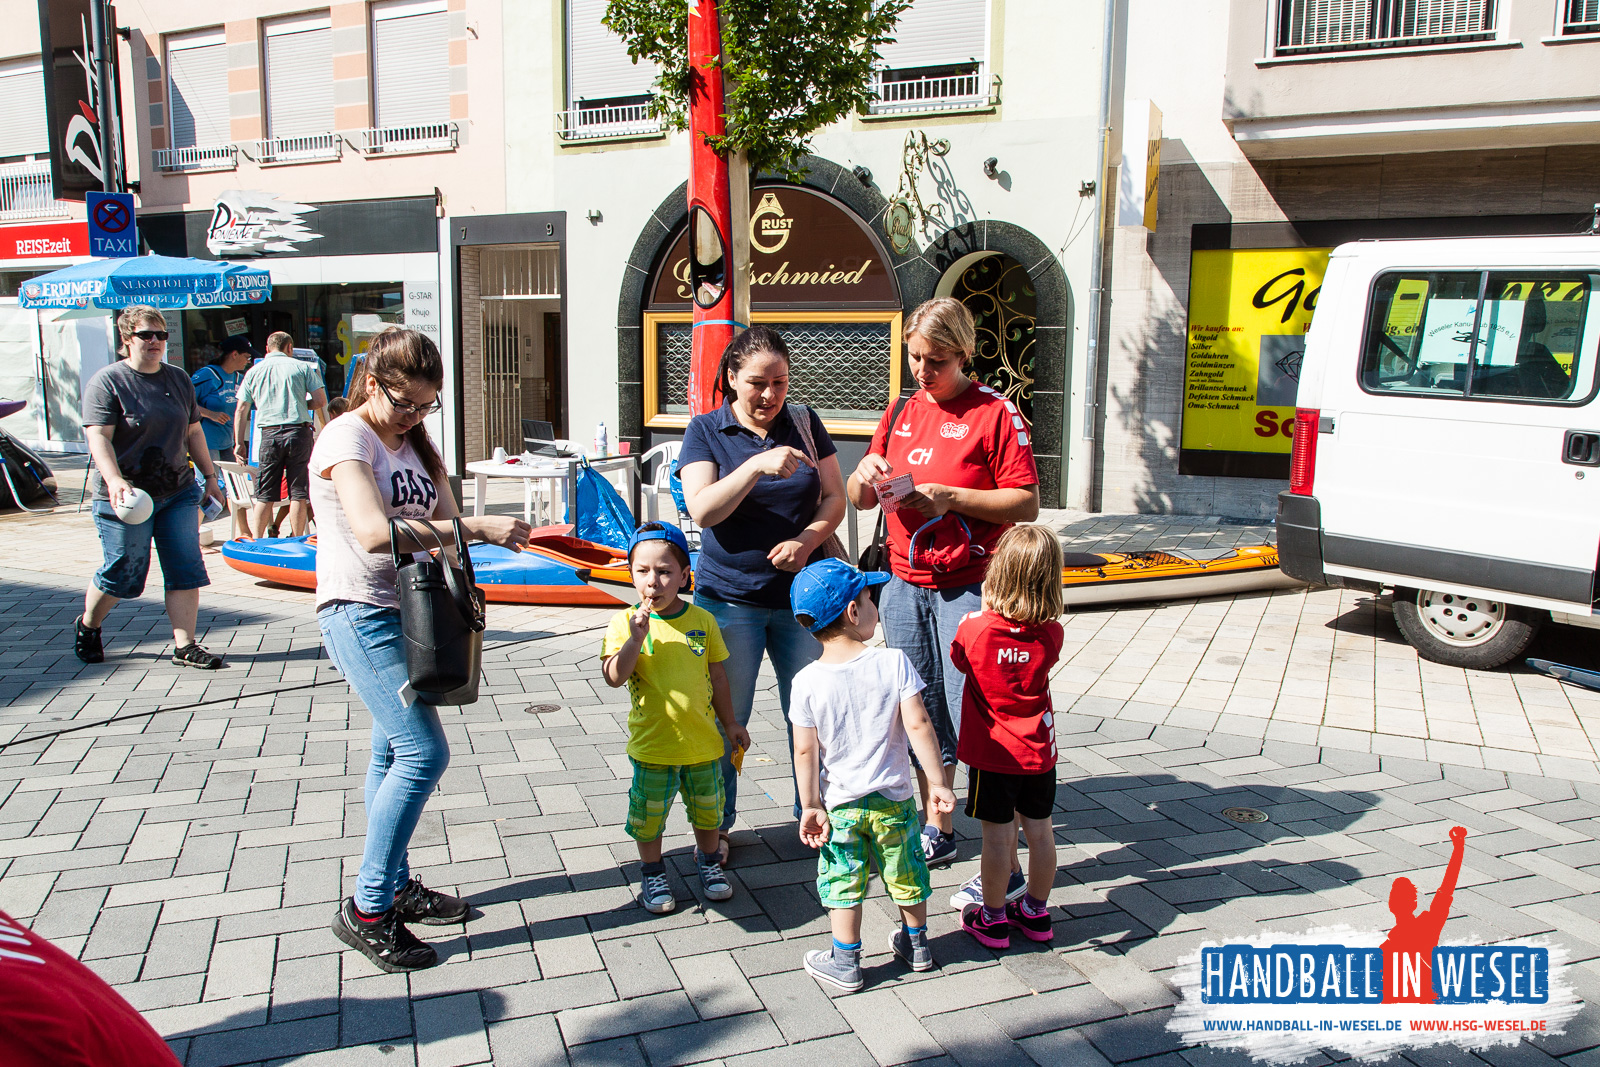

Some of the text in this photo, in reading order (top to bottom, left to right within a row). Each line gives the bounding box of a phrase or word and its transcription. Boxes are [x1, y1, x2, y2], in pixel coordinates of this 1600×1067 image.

[545, 222, 554, 236] 9
[761, 218, 793, 229] RUST
[460, 226, 468, 240] 7
[16, 237, 71, 255] REISEzeit
[94, 238, 132, 252] TAXI
[121, 278, 217, 289] ALKOHOLFREI
[236, 274, 269, 289] ERDINGER
[42, 280, 102, 297] ERDINGER
[409, 291, 432, 300] G-STAR
[411, 308, 430, 317] Khujo
[417, 324, 438, 332] EXCESS
[1190, 324, 1204, 332] Wir
[1205, 325, 1230, 333] kaufen
[1428, 323, 1453, 338] Weseler
[1490, 323, 1506, 333] 1925
[1192, 333, 1218, 342] Altgold
[1190, 352, 1229, 360] Golduhren
[1190, 361, 1235, 369] Goldmünzen
[1189, 370, 1225, 378] Zahngold
[1188, 384, 1248, 392] Brillantschmuck
[1187, 393, 1255, 402] Defekten Schmuck
[1187, 402, 1240, 410] Oma-Schmuck
[907, 447, 933, 465] CH
[391, 468, 437, 511] GAP
[997, 647, 1030, 665] Mia
